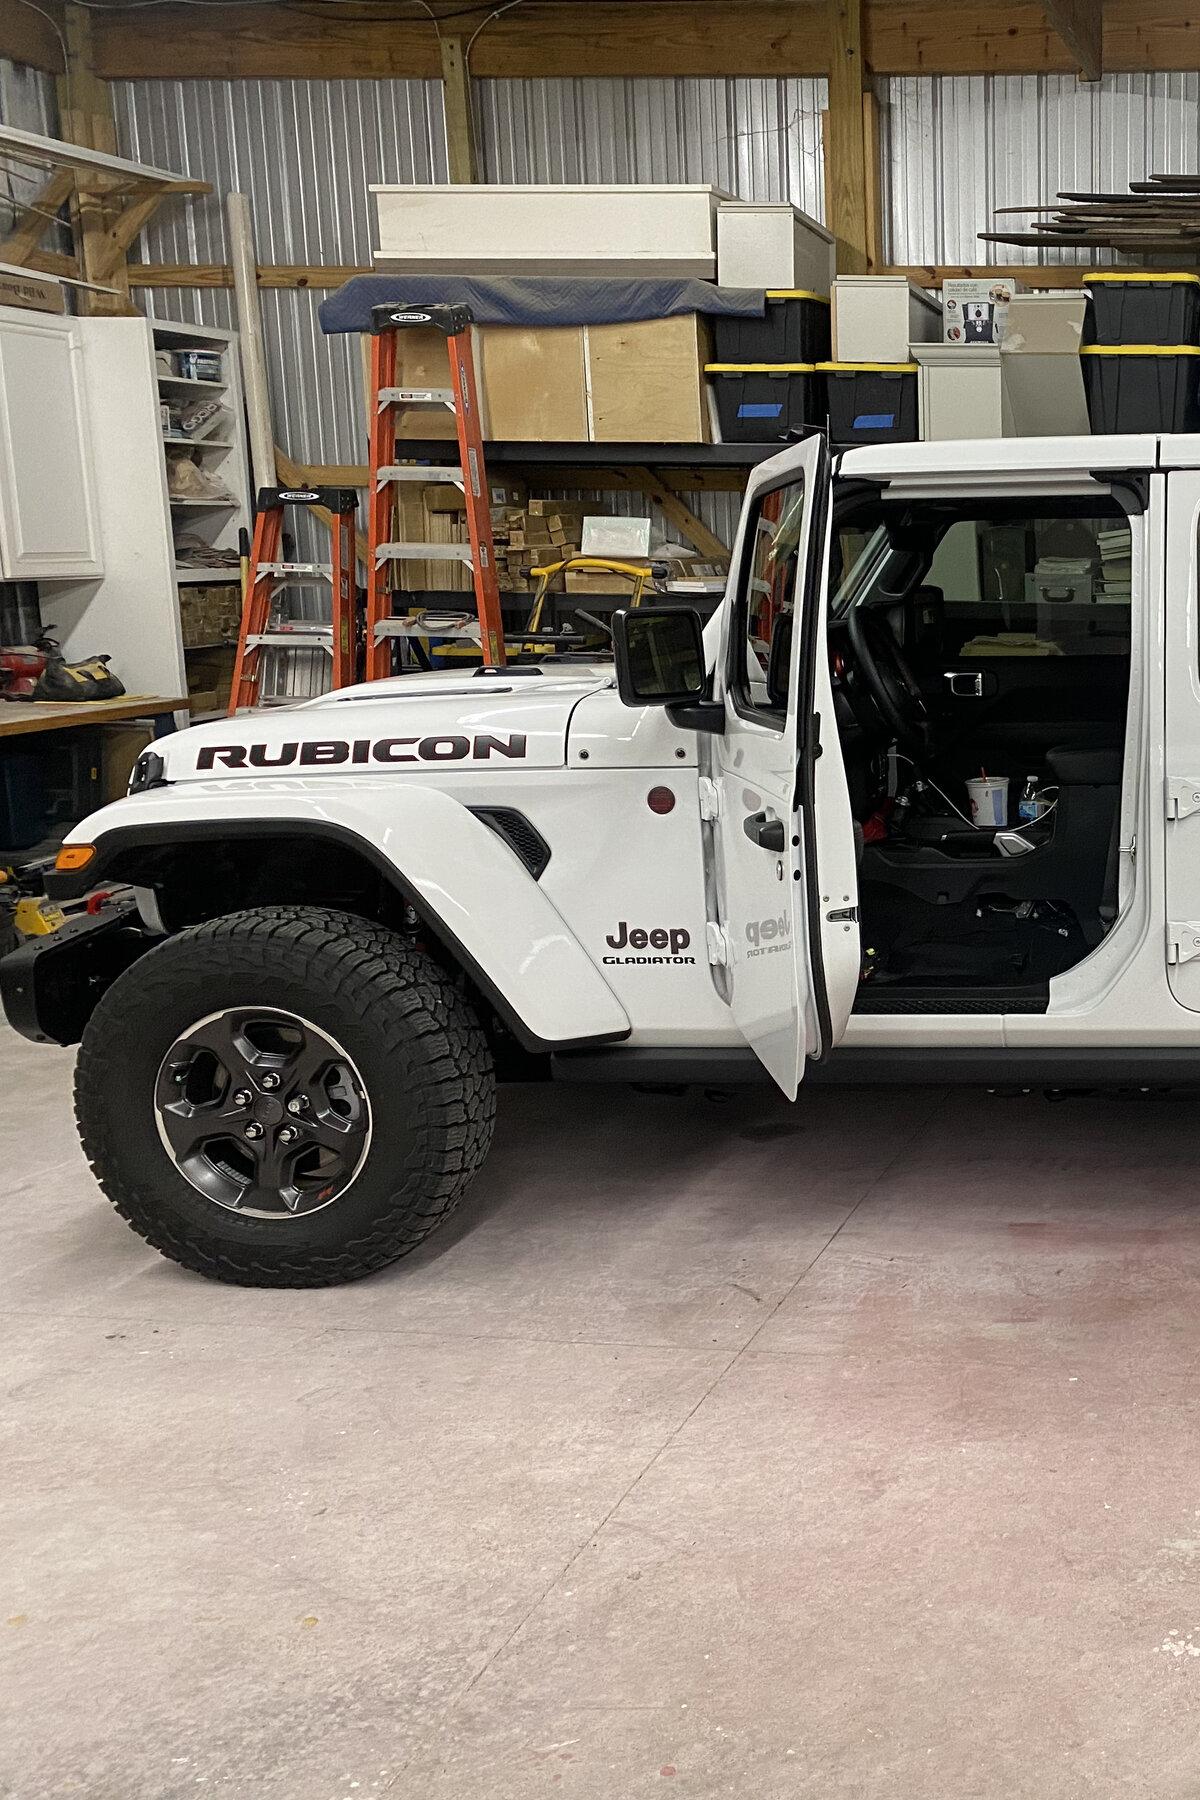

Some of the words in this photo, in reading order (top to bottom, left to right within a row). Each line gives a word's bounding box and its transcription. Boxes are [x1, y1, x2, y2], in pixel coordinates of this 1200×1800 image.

[195, 734, 527, 771] RUBICON
[605, 921, 691, 955] Jeep
[602, 956, 696, 965] GLADIATOR
